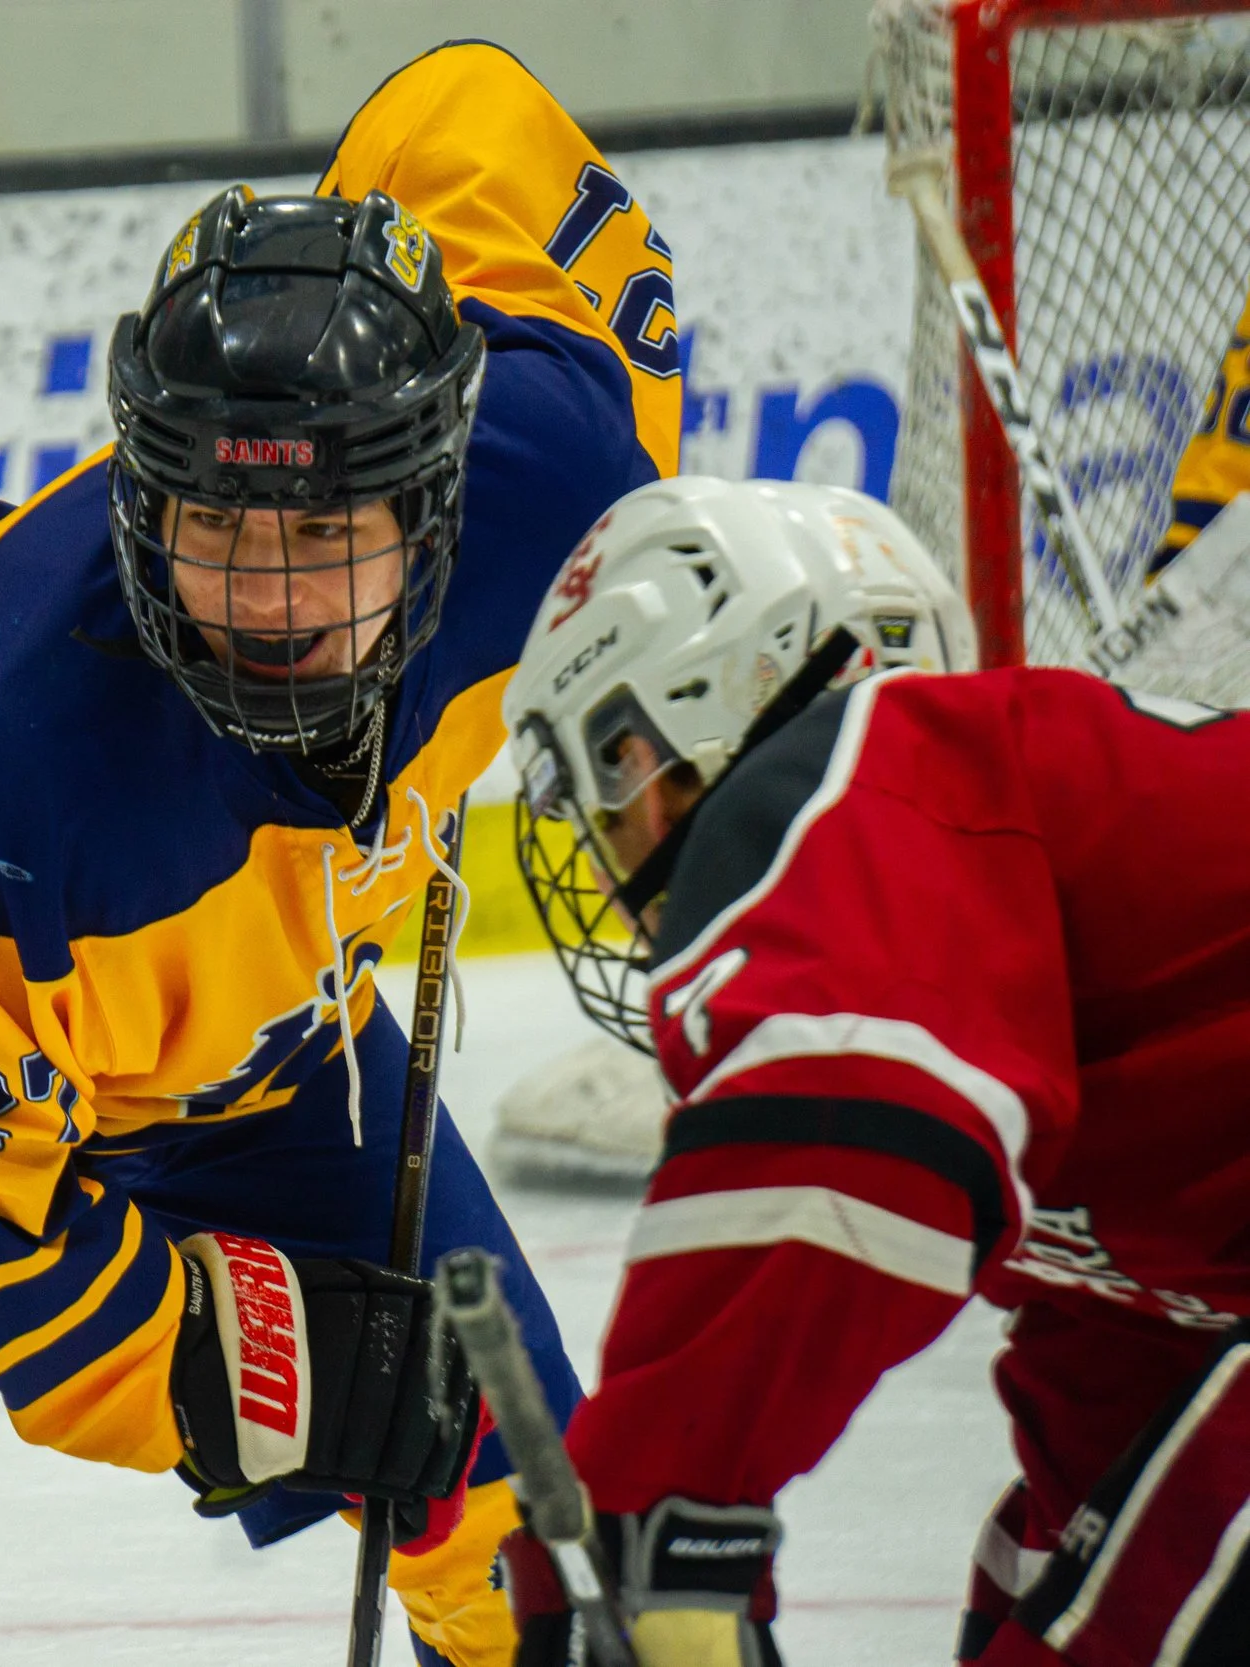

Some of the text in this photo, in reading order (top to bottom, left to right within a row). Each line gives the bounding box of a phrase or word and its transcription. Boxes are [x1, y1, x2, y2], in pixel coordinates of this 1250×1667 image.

[215, 437, 314, 467] SAINTS
[553, 624, 618, 694] CCM
[411, 881, 454, 1073] RIBCOR
[668, 1536, 763, 1558] BAUER
